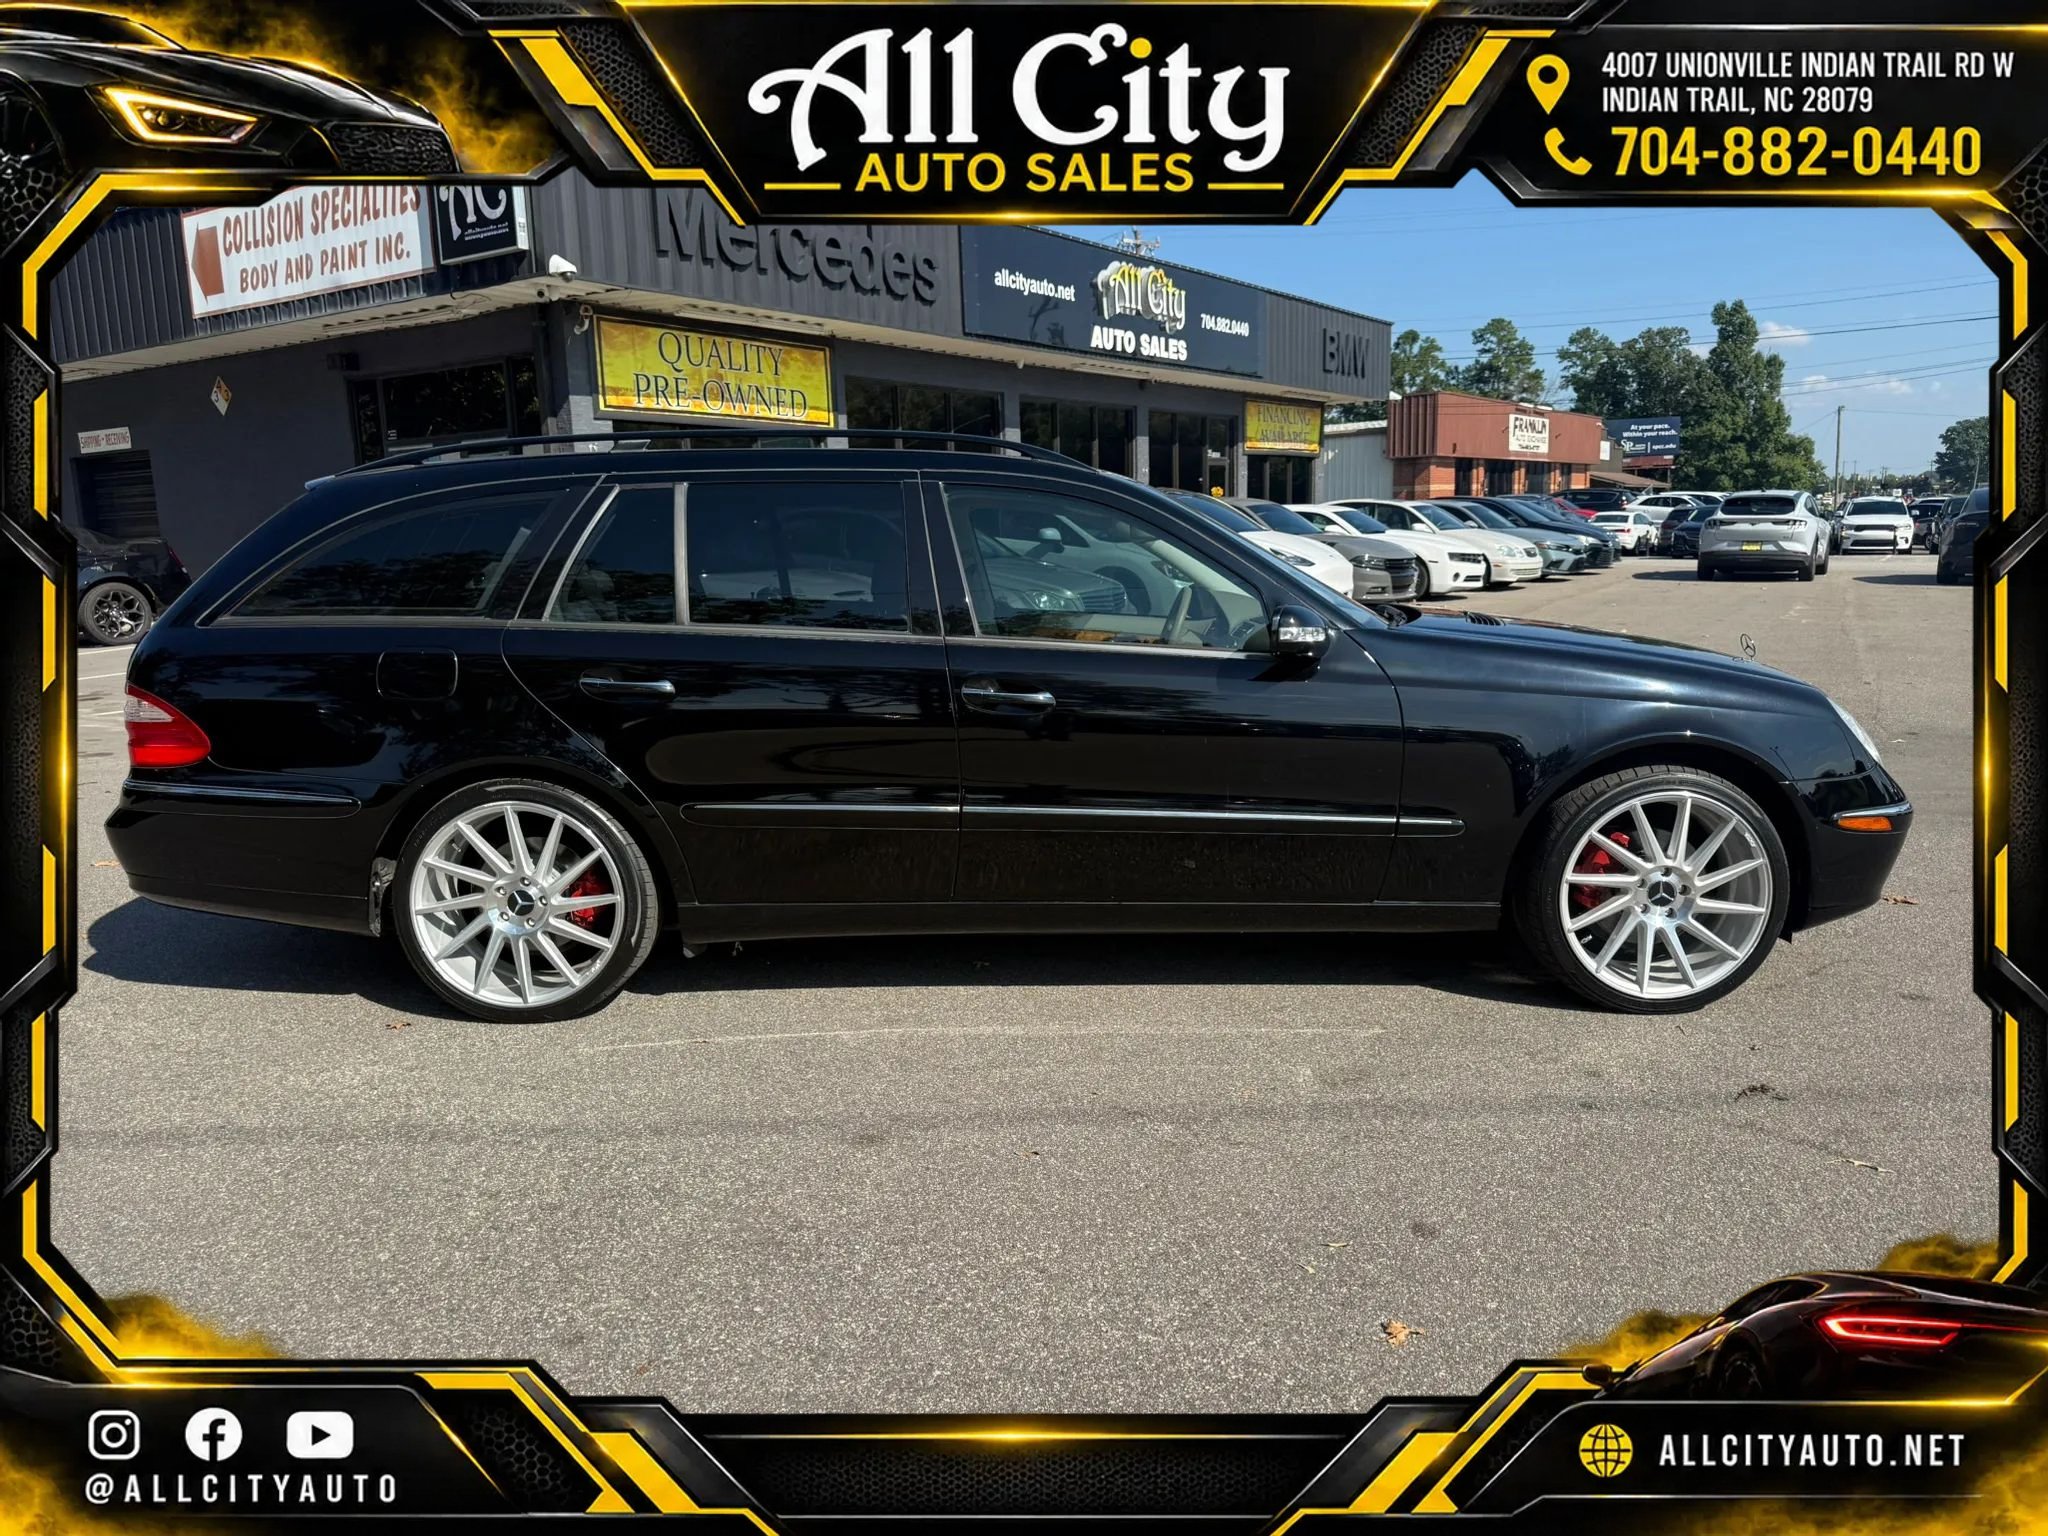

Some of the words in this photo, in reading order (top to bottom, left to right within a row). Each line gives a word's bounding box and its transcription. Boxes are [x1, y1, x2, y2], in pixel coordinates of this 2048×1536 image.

[222, 196, 304, 257] COLLISION
[652, 188, 939, 306] Mercedes
[240, 260, 278, 293] BODY
[285, 253, 313, 285] AND
[320, 240, 368, 276] PAINT
[375, 232, 410, 265] INC.
[994, 268, 1075, 302] allcityauto.net
[1098, 261, 1143, 319] All
[1145, 267, 1186, 332] City
[1090, 326, 1136, 353] AUTO
[1140, 337, 1188, 361] SALES
[1200, 314, 1250, 337] 704.882.0440
[658, 332, 784, 376] QUALITY
[1323, 328, 1370, 379] BMW
[634, 373, 807, 419] PRE-OWNED
[1257, 405, 1311, 425] FINANCING
[1513, 416, 1547, 437] FRANKLIN
